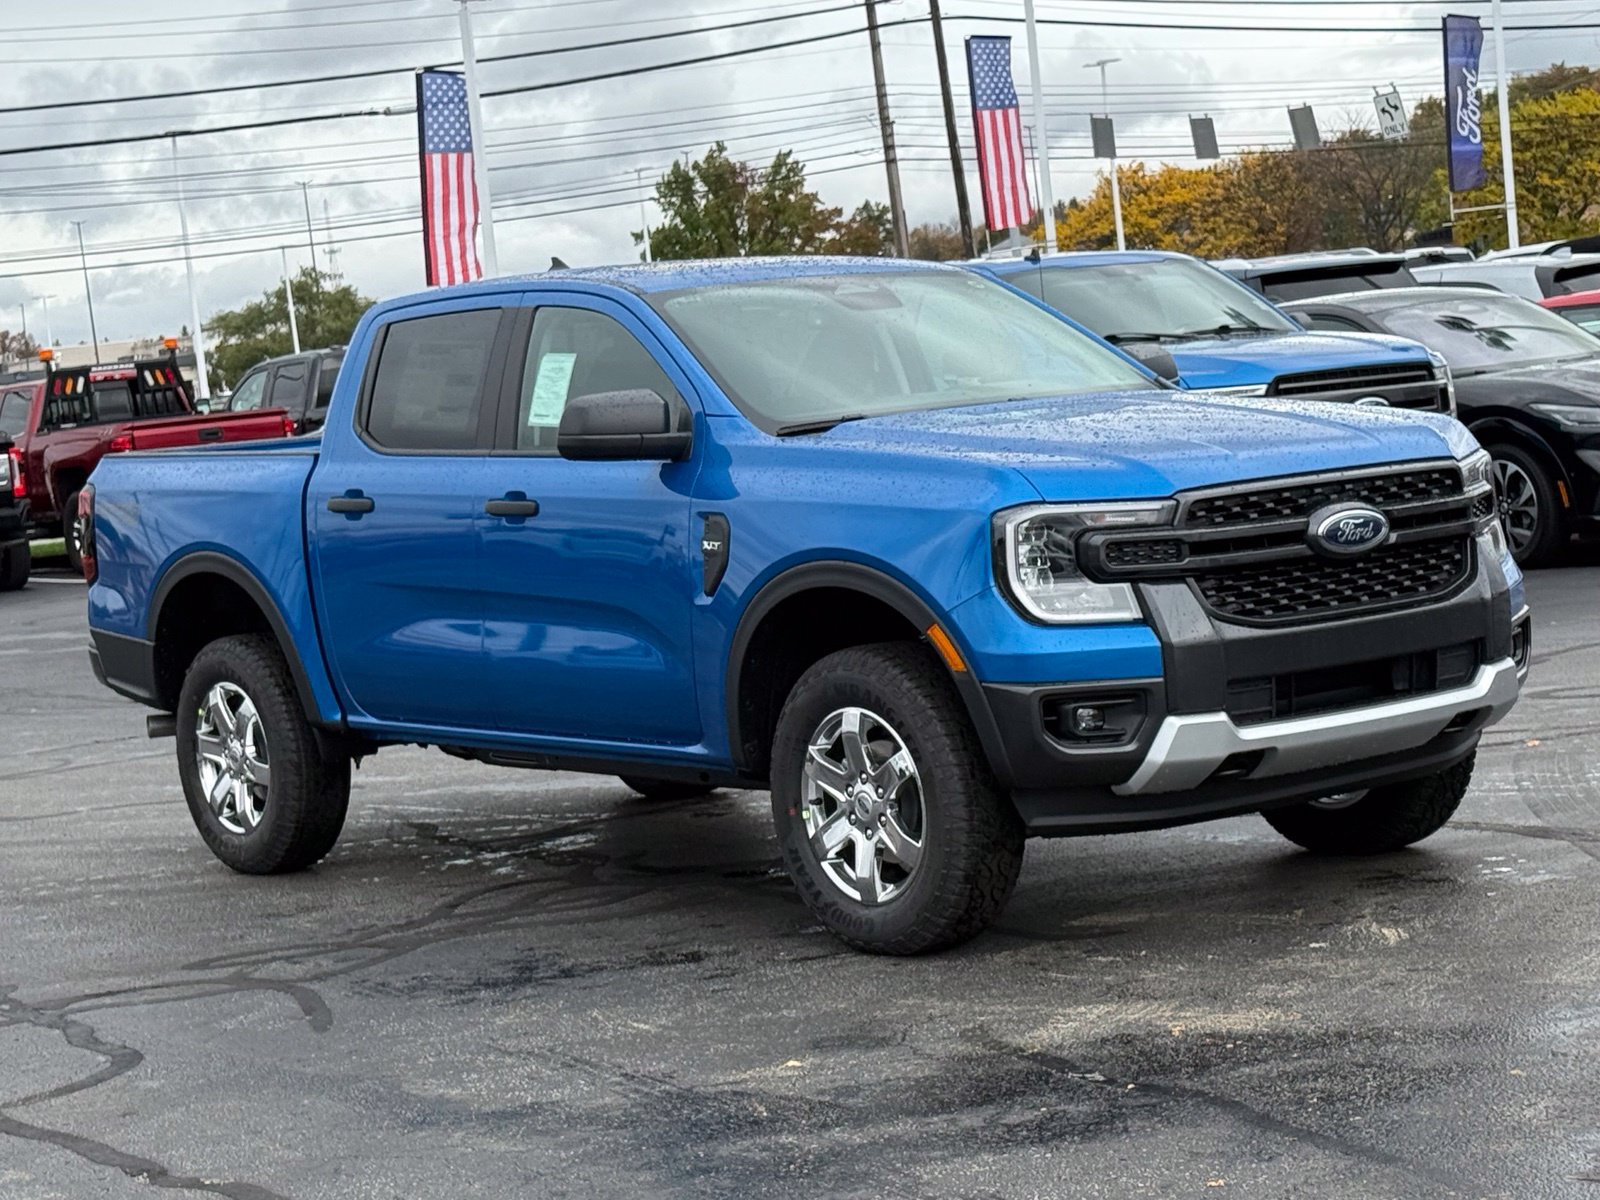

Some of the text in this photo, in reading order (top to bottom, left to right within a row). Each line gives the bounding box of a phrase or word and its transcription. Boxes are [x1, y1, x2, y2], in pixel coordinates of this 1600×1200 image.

[1456, 67, 1482, 144] Ford
[1384, 123, 1405, 136] ONLY
[1337, 518, 1374, 543] Ford
[702, 540, 722, 550] XLT
